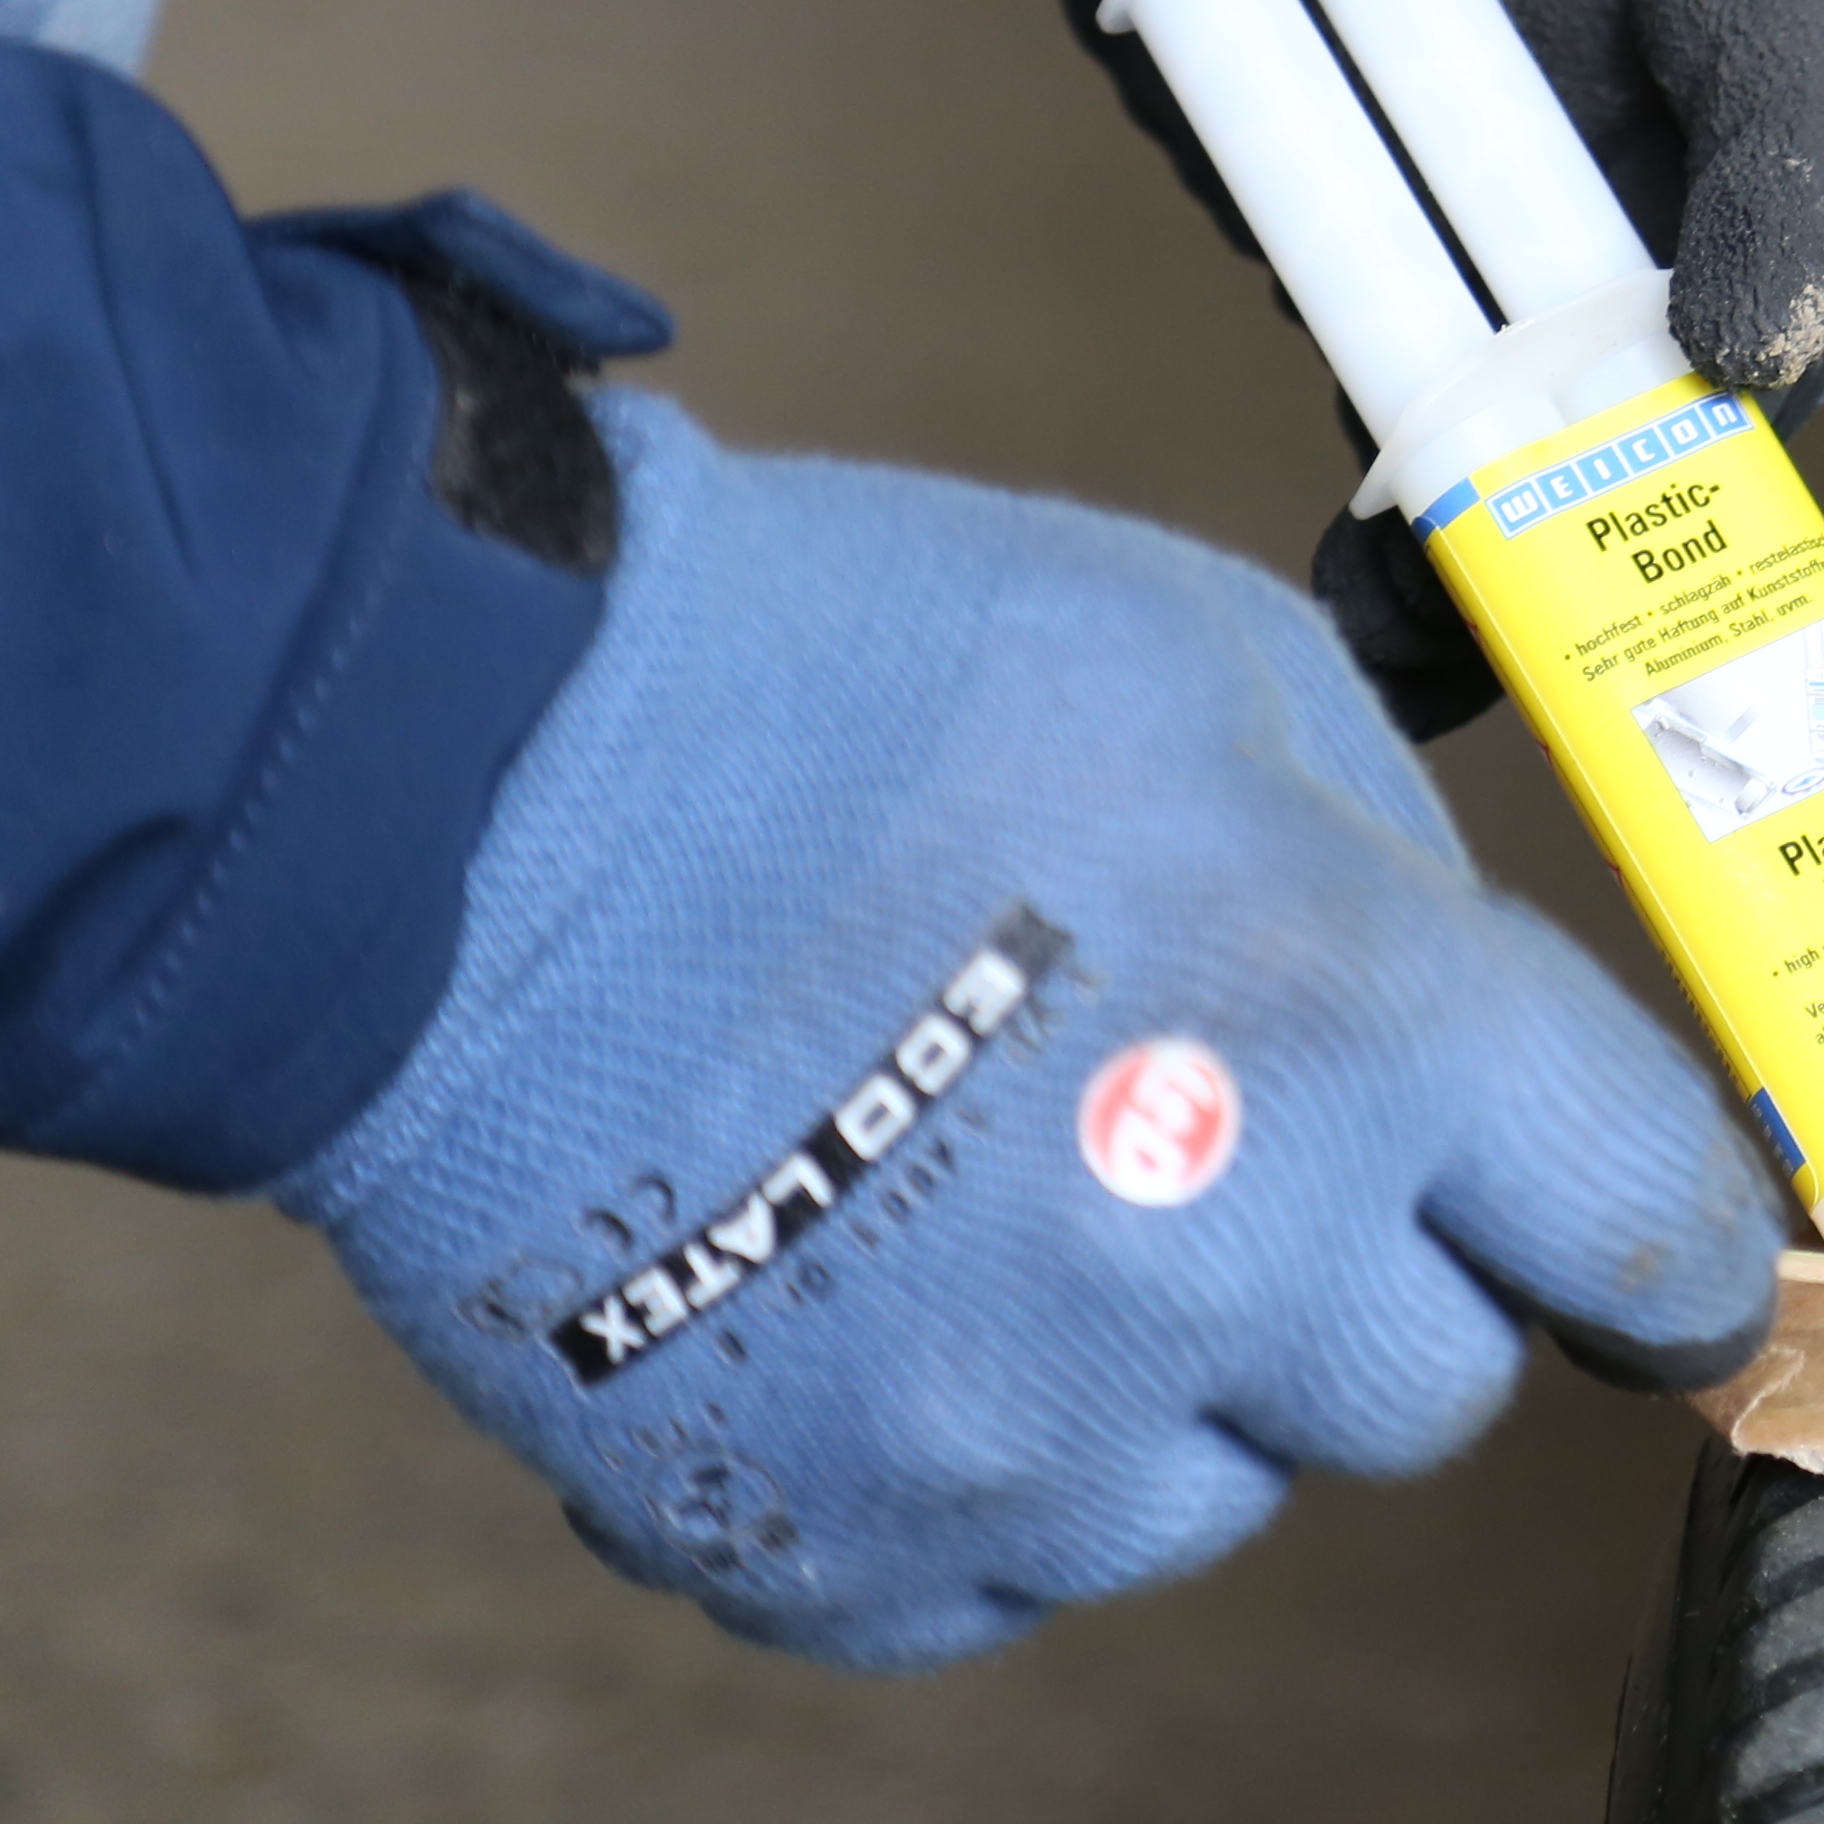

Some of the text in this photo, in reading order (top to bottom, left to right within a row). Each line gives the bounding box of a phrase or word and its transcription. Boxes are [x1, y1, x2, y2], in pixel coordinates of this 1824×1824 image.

[1586, 484, 1719, 551] Plastic-
[1632, 520, 1727, 583] Bond
[1575, 616, 1642, 656] hochfest
[1583, 655, 1618, 681] Sehr
[1624, 638, 1656, 662] gute
[1658, 610, 1719, 641] Haftung
[1722, 594, 1744, 613] auf
[1784, 949, 1819, 972] high
[838, 954, 1021, 1155] ECO
[588, 1155, 830, 1354] LATEX
